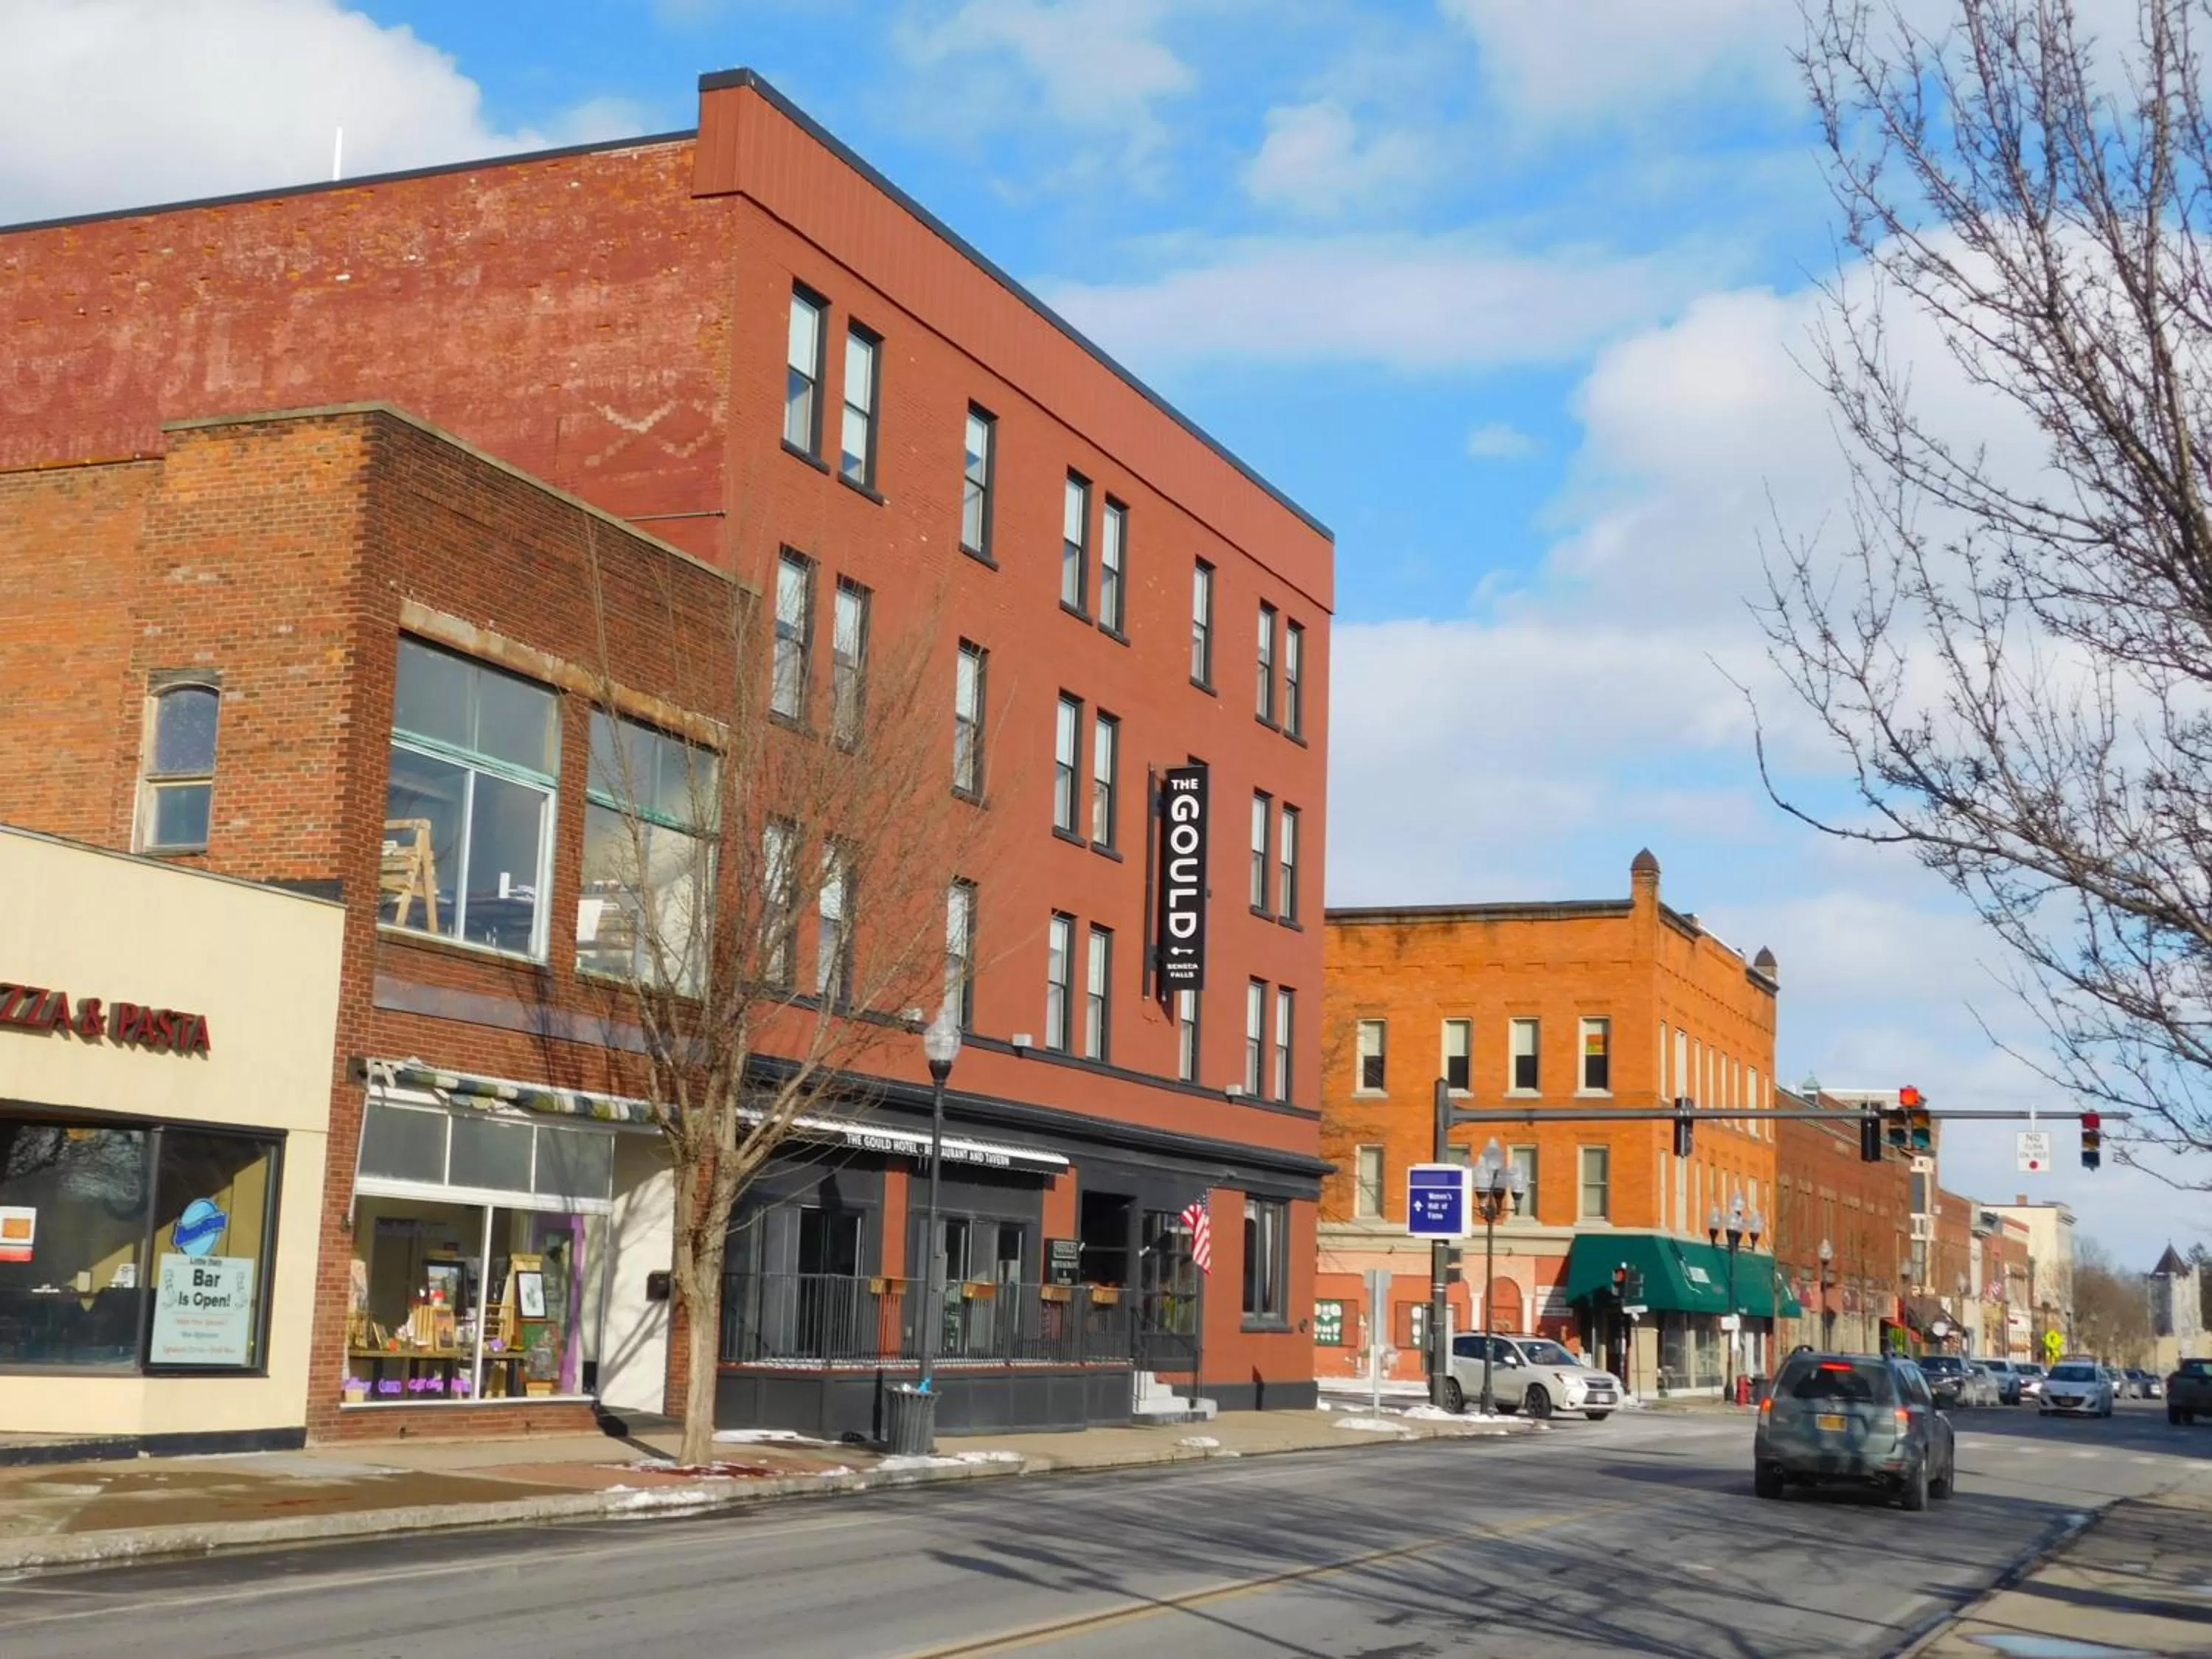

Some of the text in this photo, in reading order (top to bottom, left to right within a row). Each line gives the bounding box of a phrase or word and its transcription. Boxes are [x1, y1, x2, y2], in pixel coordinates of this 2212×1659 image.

[1171, 779, 1198, 790] THE
[1169, 794, 1200, 939] GOULD
[82, 998, 107, 1036] &
[119, 1002, 211, 1051] PASTA
[846, 1133, 862, 1146] THE
[863, 1135, 891, 1150] GOULD
[893, 1139, 918, 1155] HOTEL
[924, 1144, 967, 1160] REAURANT
[969, 1150, 984, 1163] AND
[193, 1268, 221, 1287] Bar
[178, 1290, 231, 1310] Is Open!
